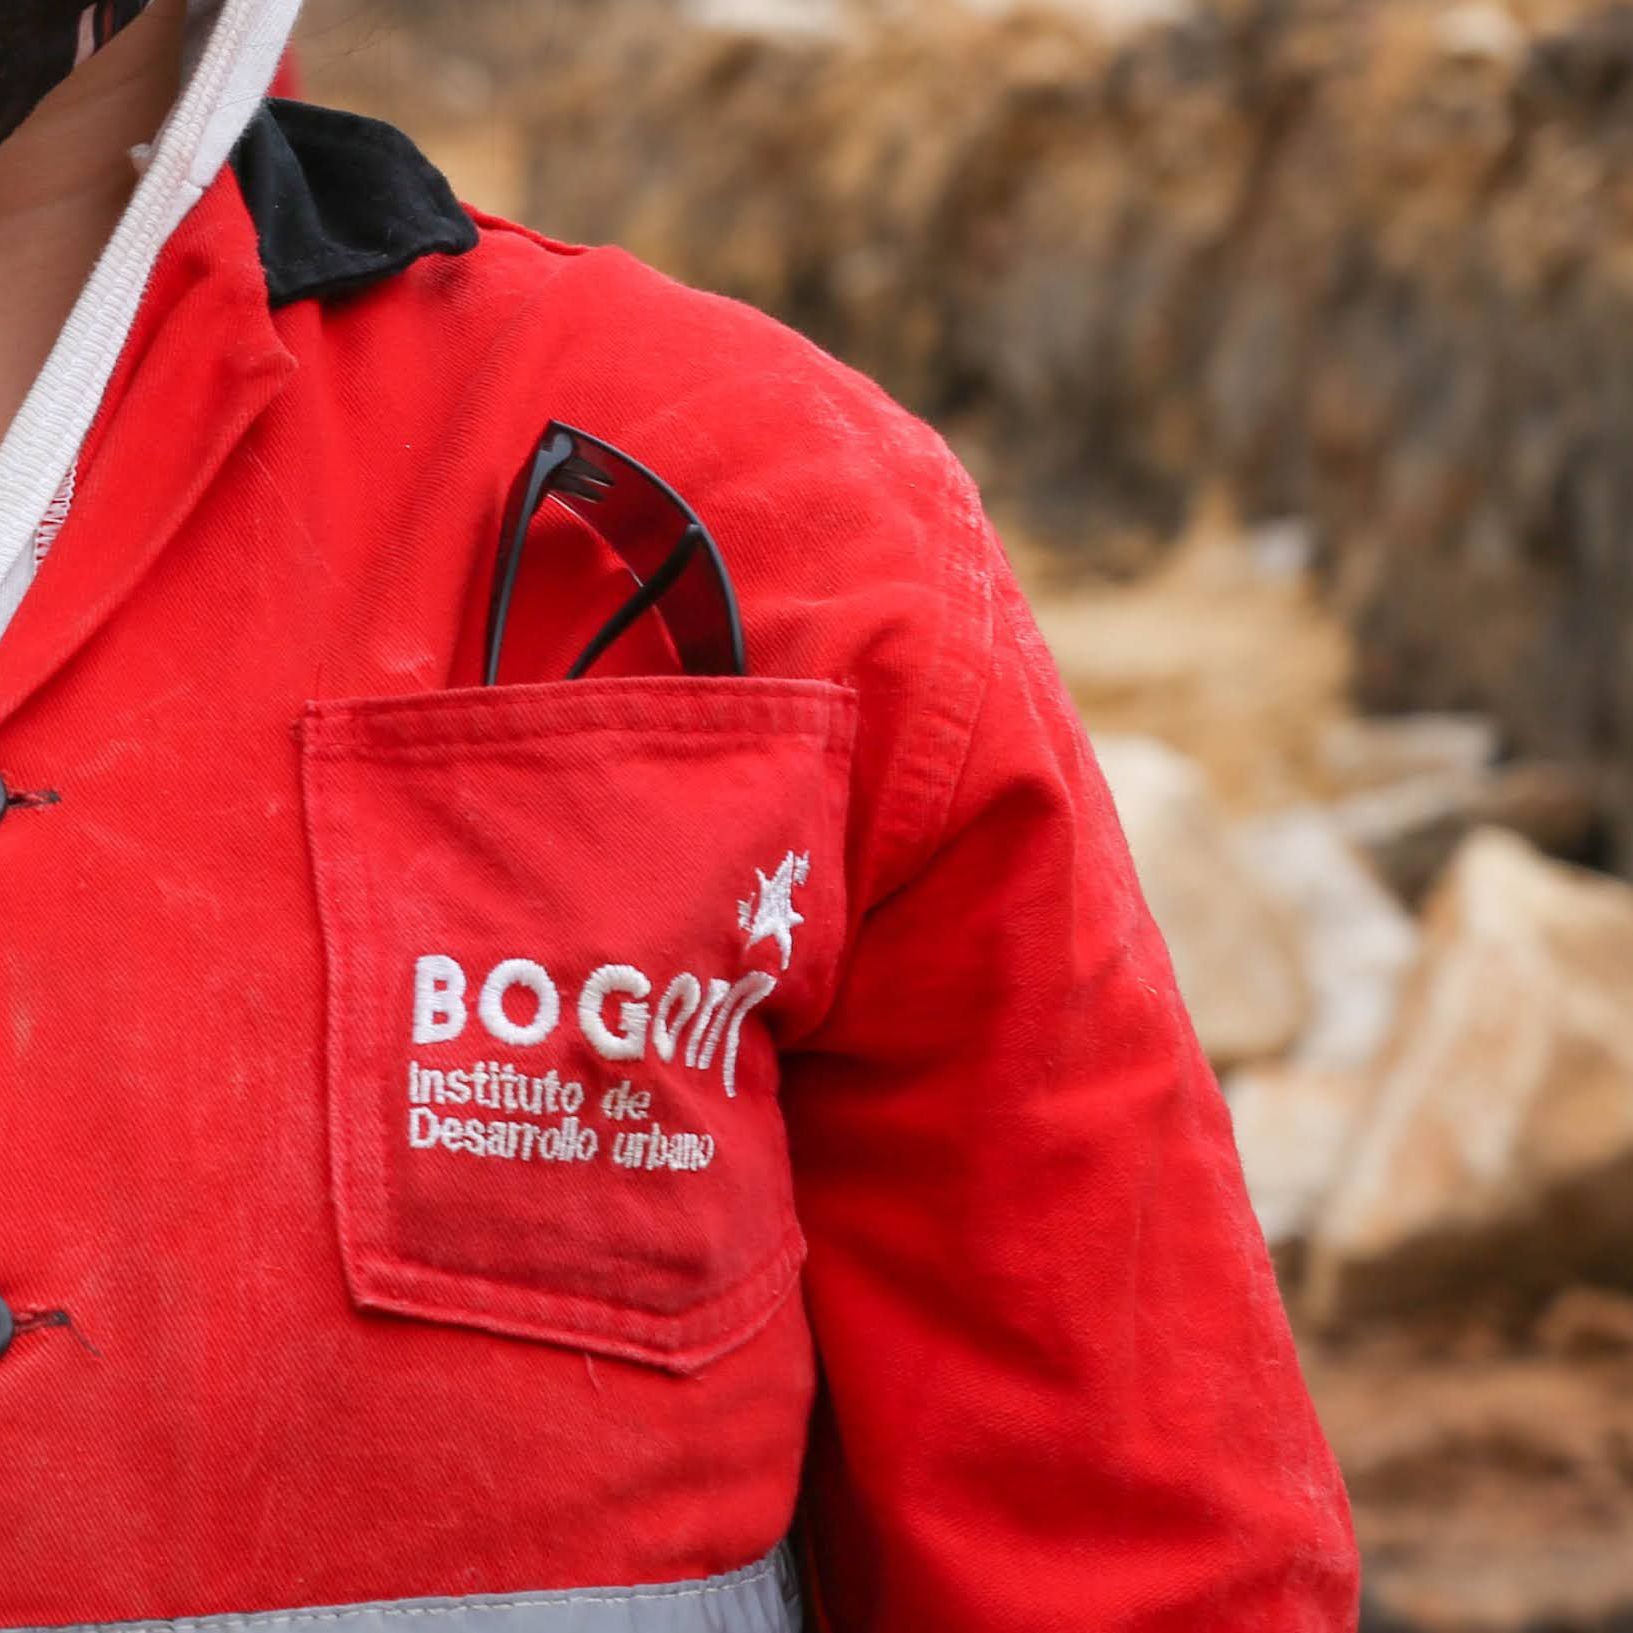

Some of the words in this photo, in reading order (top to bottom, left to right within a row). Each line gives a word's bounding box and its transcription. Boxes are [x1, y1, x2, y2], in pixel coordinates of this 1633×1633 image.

[408, 1060, 584, 1115] Instituto
[601, 1079, 651, 1120] de
[408, 1107, 599, 1161] Desarrollo
[612, 1122, 716, 1171] urbano
